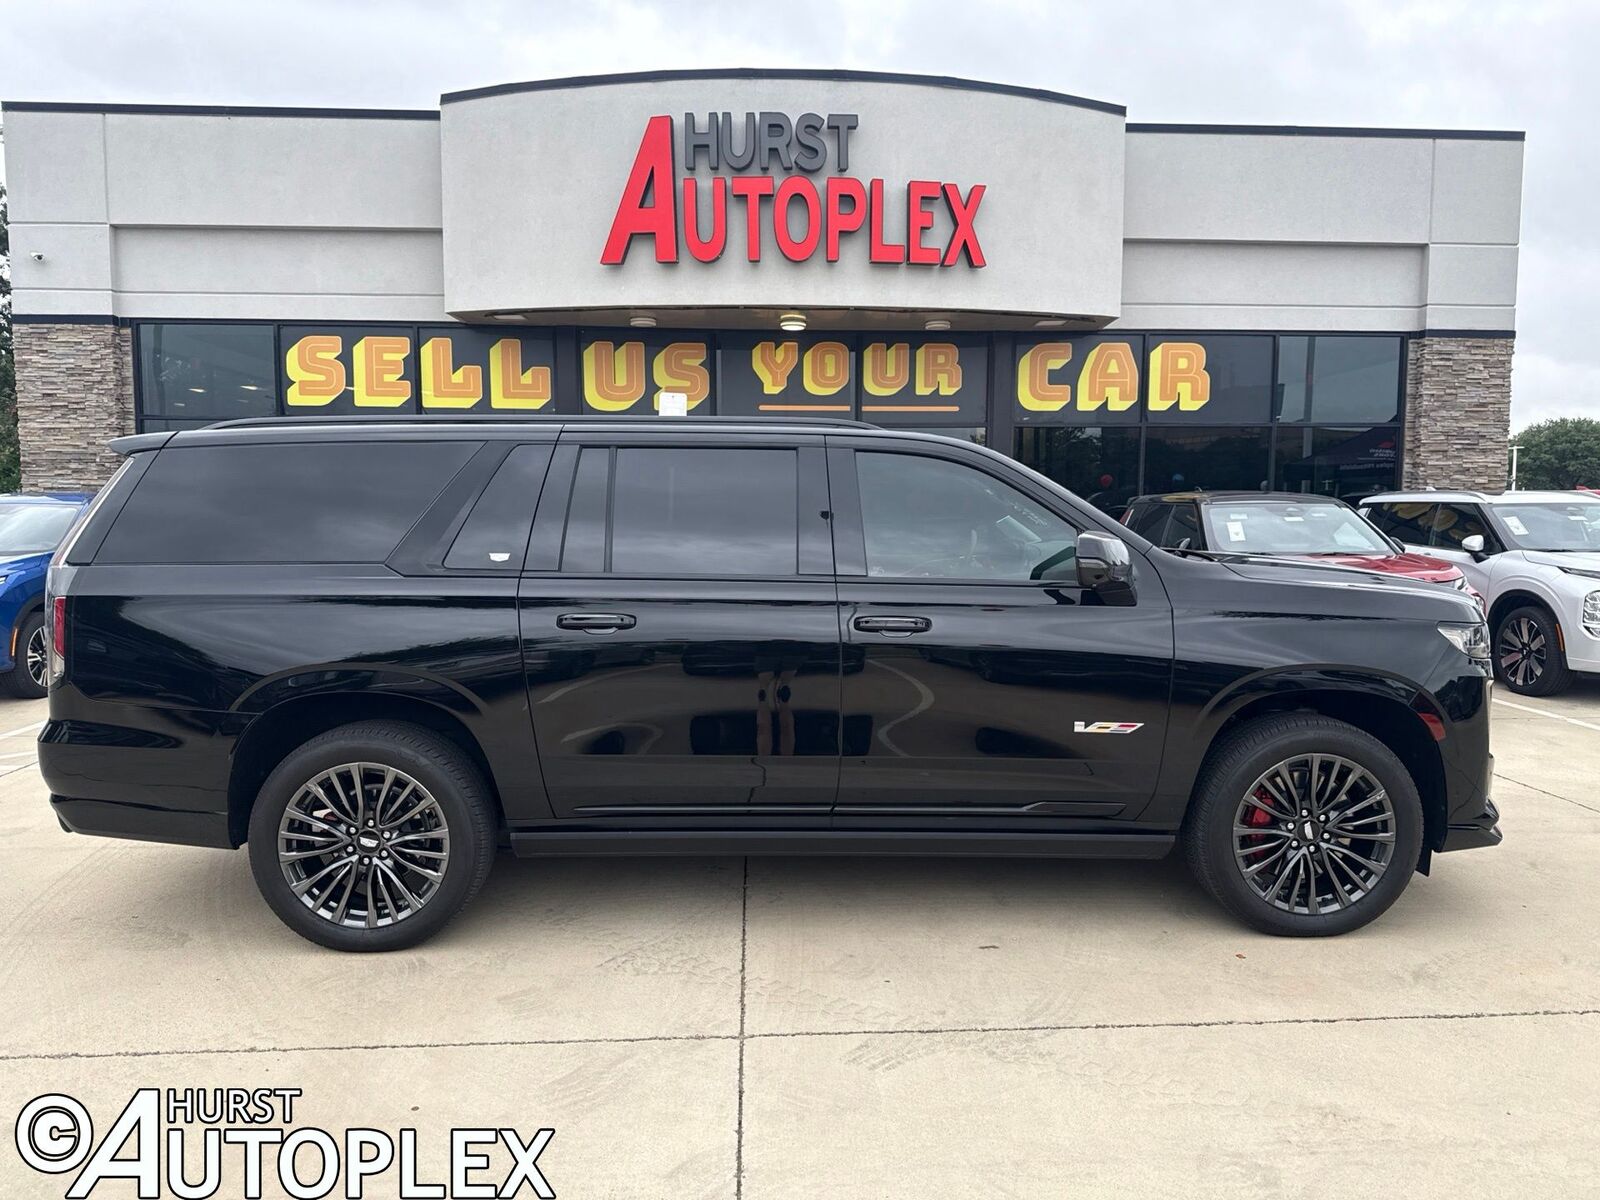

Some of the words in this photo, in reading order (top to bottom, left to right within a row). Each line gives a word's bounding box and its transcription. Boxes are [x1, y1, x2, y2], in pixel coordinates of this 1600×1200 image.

[684, 112, 859, 172] HURST
[600, 115, 987, 268] AUTOPLEX
[286, 335, 552, 409] SELL
[583, 341, 710, 412] US
[751, 340, 963, 396] YOUR
[1017, 341, 1211, 411] CAR
